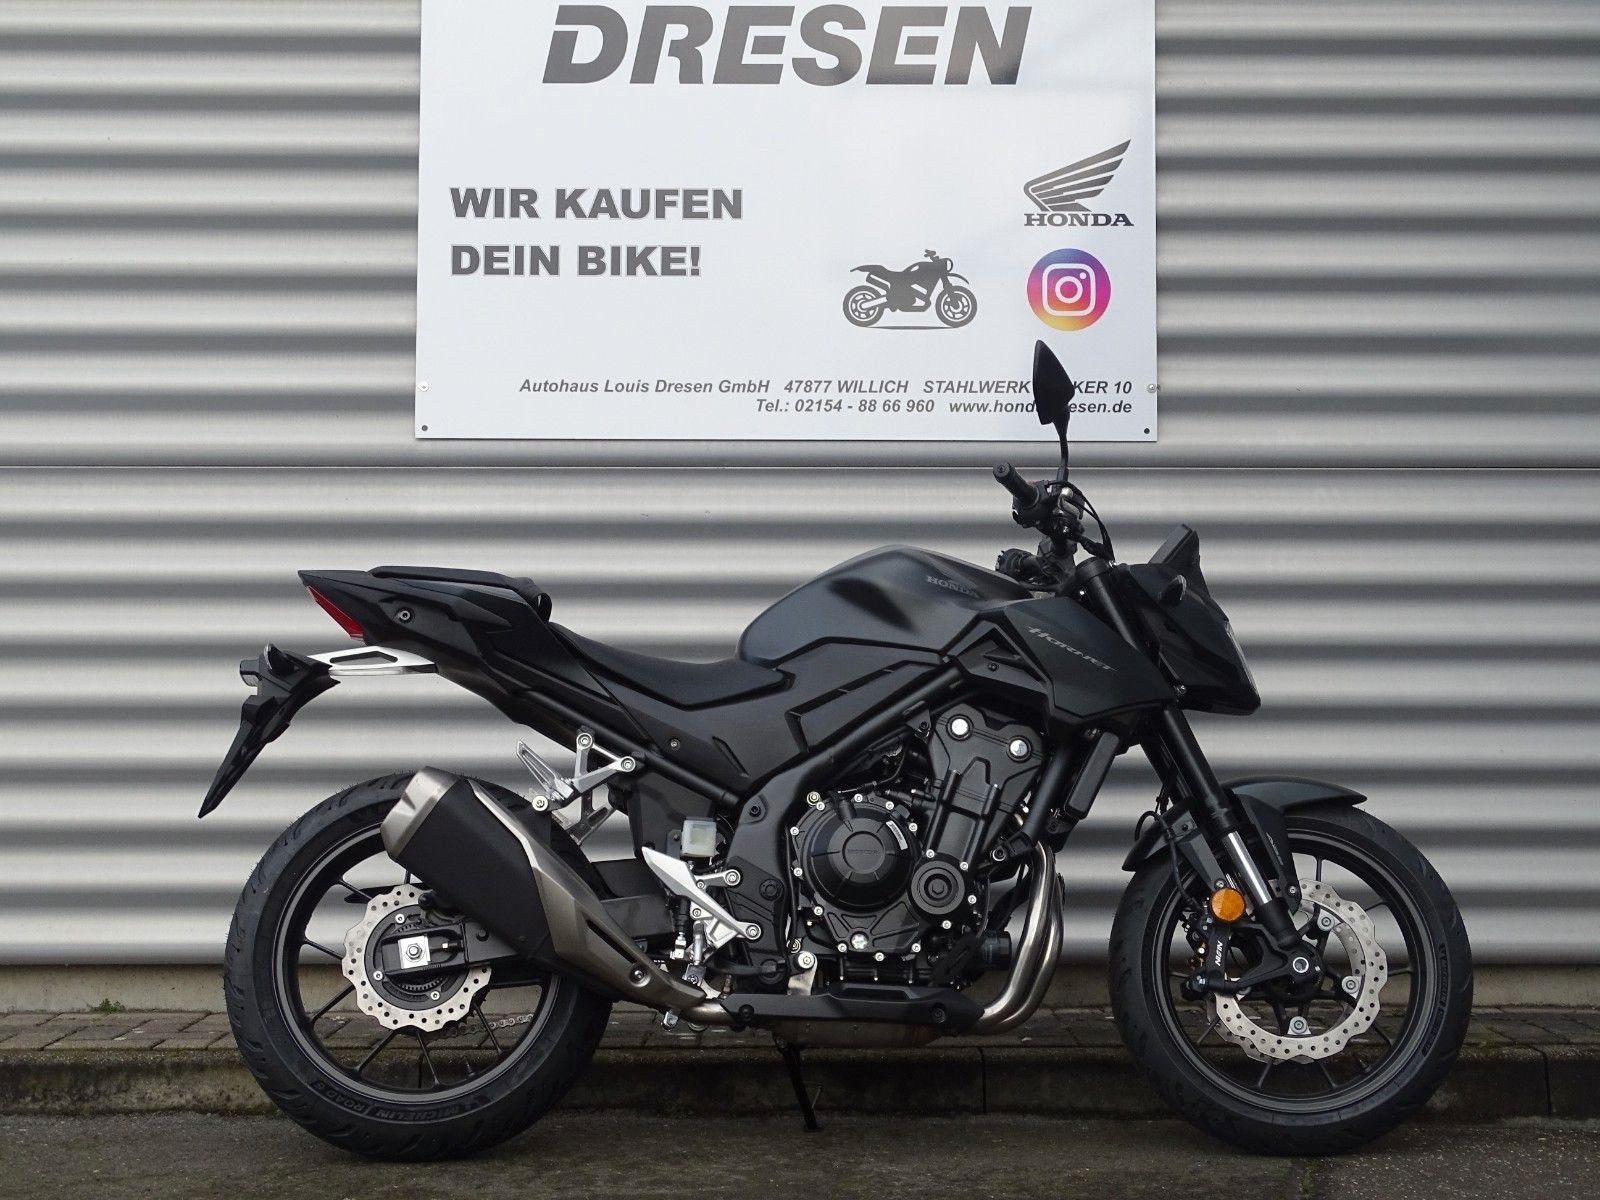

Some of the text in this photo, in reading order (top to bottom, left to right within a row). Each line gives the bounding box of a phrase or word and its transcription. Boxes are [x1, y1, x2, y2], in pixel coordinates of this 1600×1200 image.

[543, 4, 1032, 86] DRESEN
[450, 188, 743, 219] WIR KAUFEN
[1024, 213, 1135, 227] HONDA
[451, 245, 701, 277] DEIN BIKE!
[519, 379, 599, 393] Autohaus
[604, 379, 649, 393] Louis
[655, 380, 713, 393] Dresen
[718, 379, 770, 393] GmbH
[784, 380, 832, 393] 47877
[837, 380, 909, 394] WILLICH
[923, 380, 1031, 394] STAHLWERK
[1114, 381, 1132, 394] 10
[757, 399, 790, 413] Tel.:
[794, 399, 842, 413] 02154
[858, 399, 877, 413] 88
[882, 399, 901, 413] 66
[906, 399, 935, 413] 960
[949, 399, 1132, 413] www.hondesen.de
[926, 575, 981, 599] HONDA
